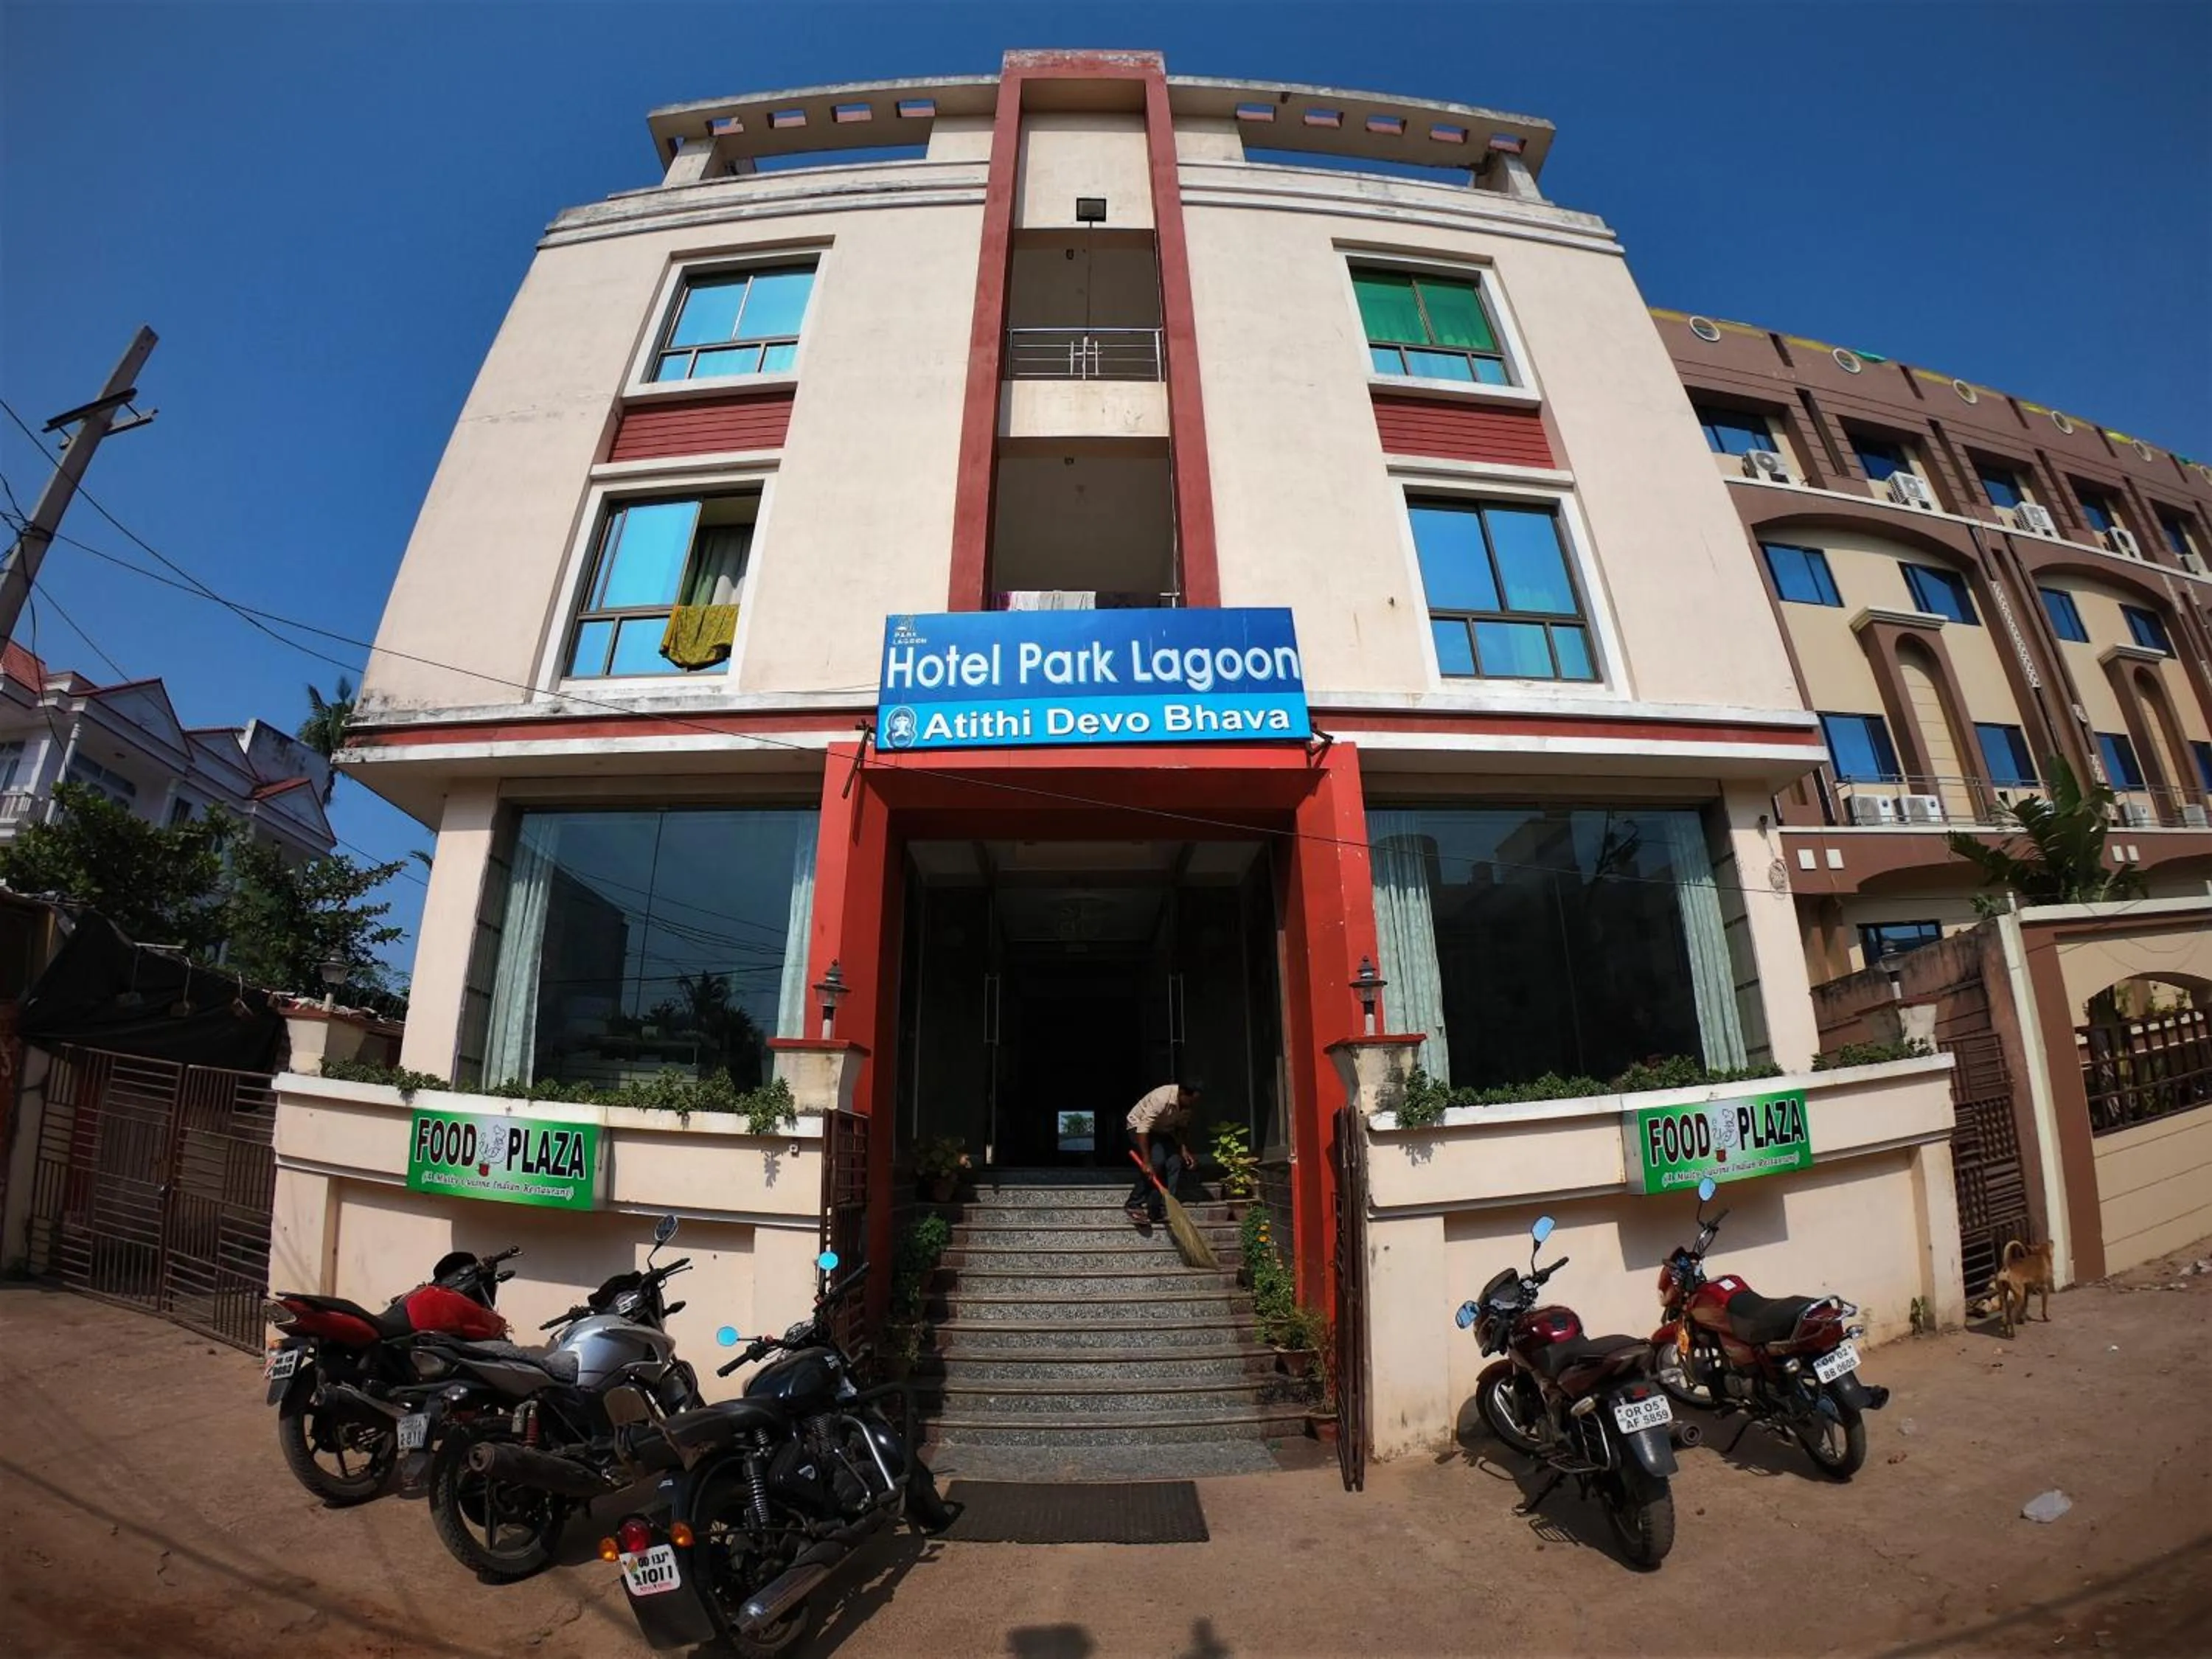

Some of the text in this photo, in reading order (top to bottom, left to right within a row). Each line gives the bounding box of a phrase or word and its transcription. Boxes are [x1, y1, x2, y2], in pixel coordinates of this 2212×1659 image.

[887, 640, 1301, 692] Hotel Park Lagoon
[922, 703, 1290, 740] Atithi Devo Bhava
[414, 1118, 586, 1180] FOOD PLAZA
[1646, 1099, 1806, 1167] FOOD PLAZA
[493, 1180, 519, 1190] Indian
[1625, 1401, 1660, 1417] OR 05
[1627, 1410, 1669, 1429] AF 5859
